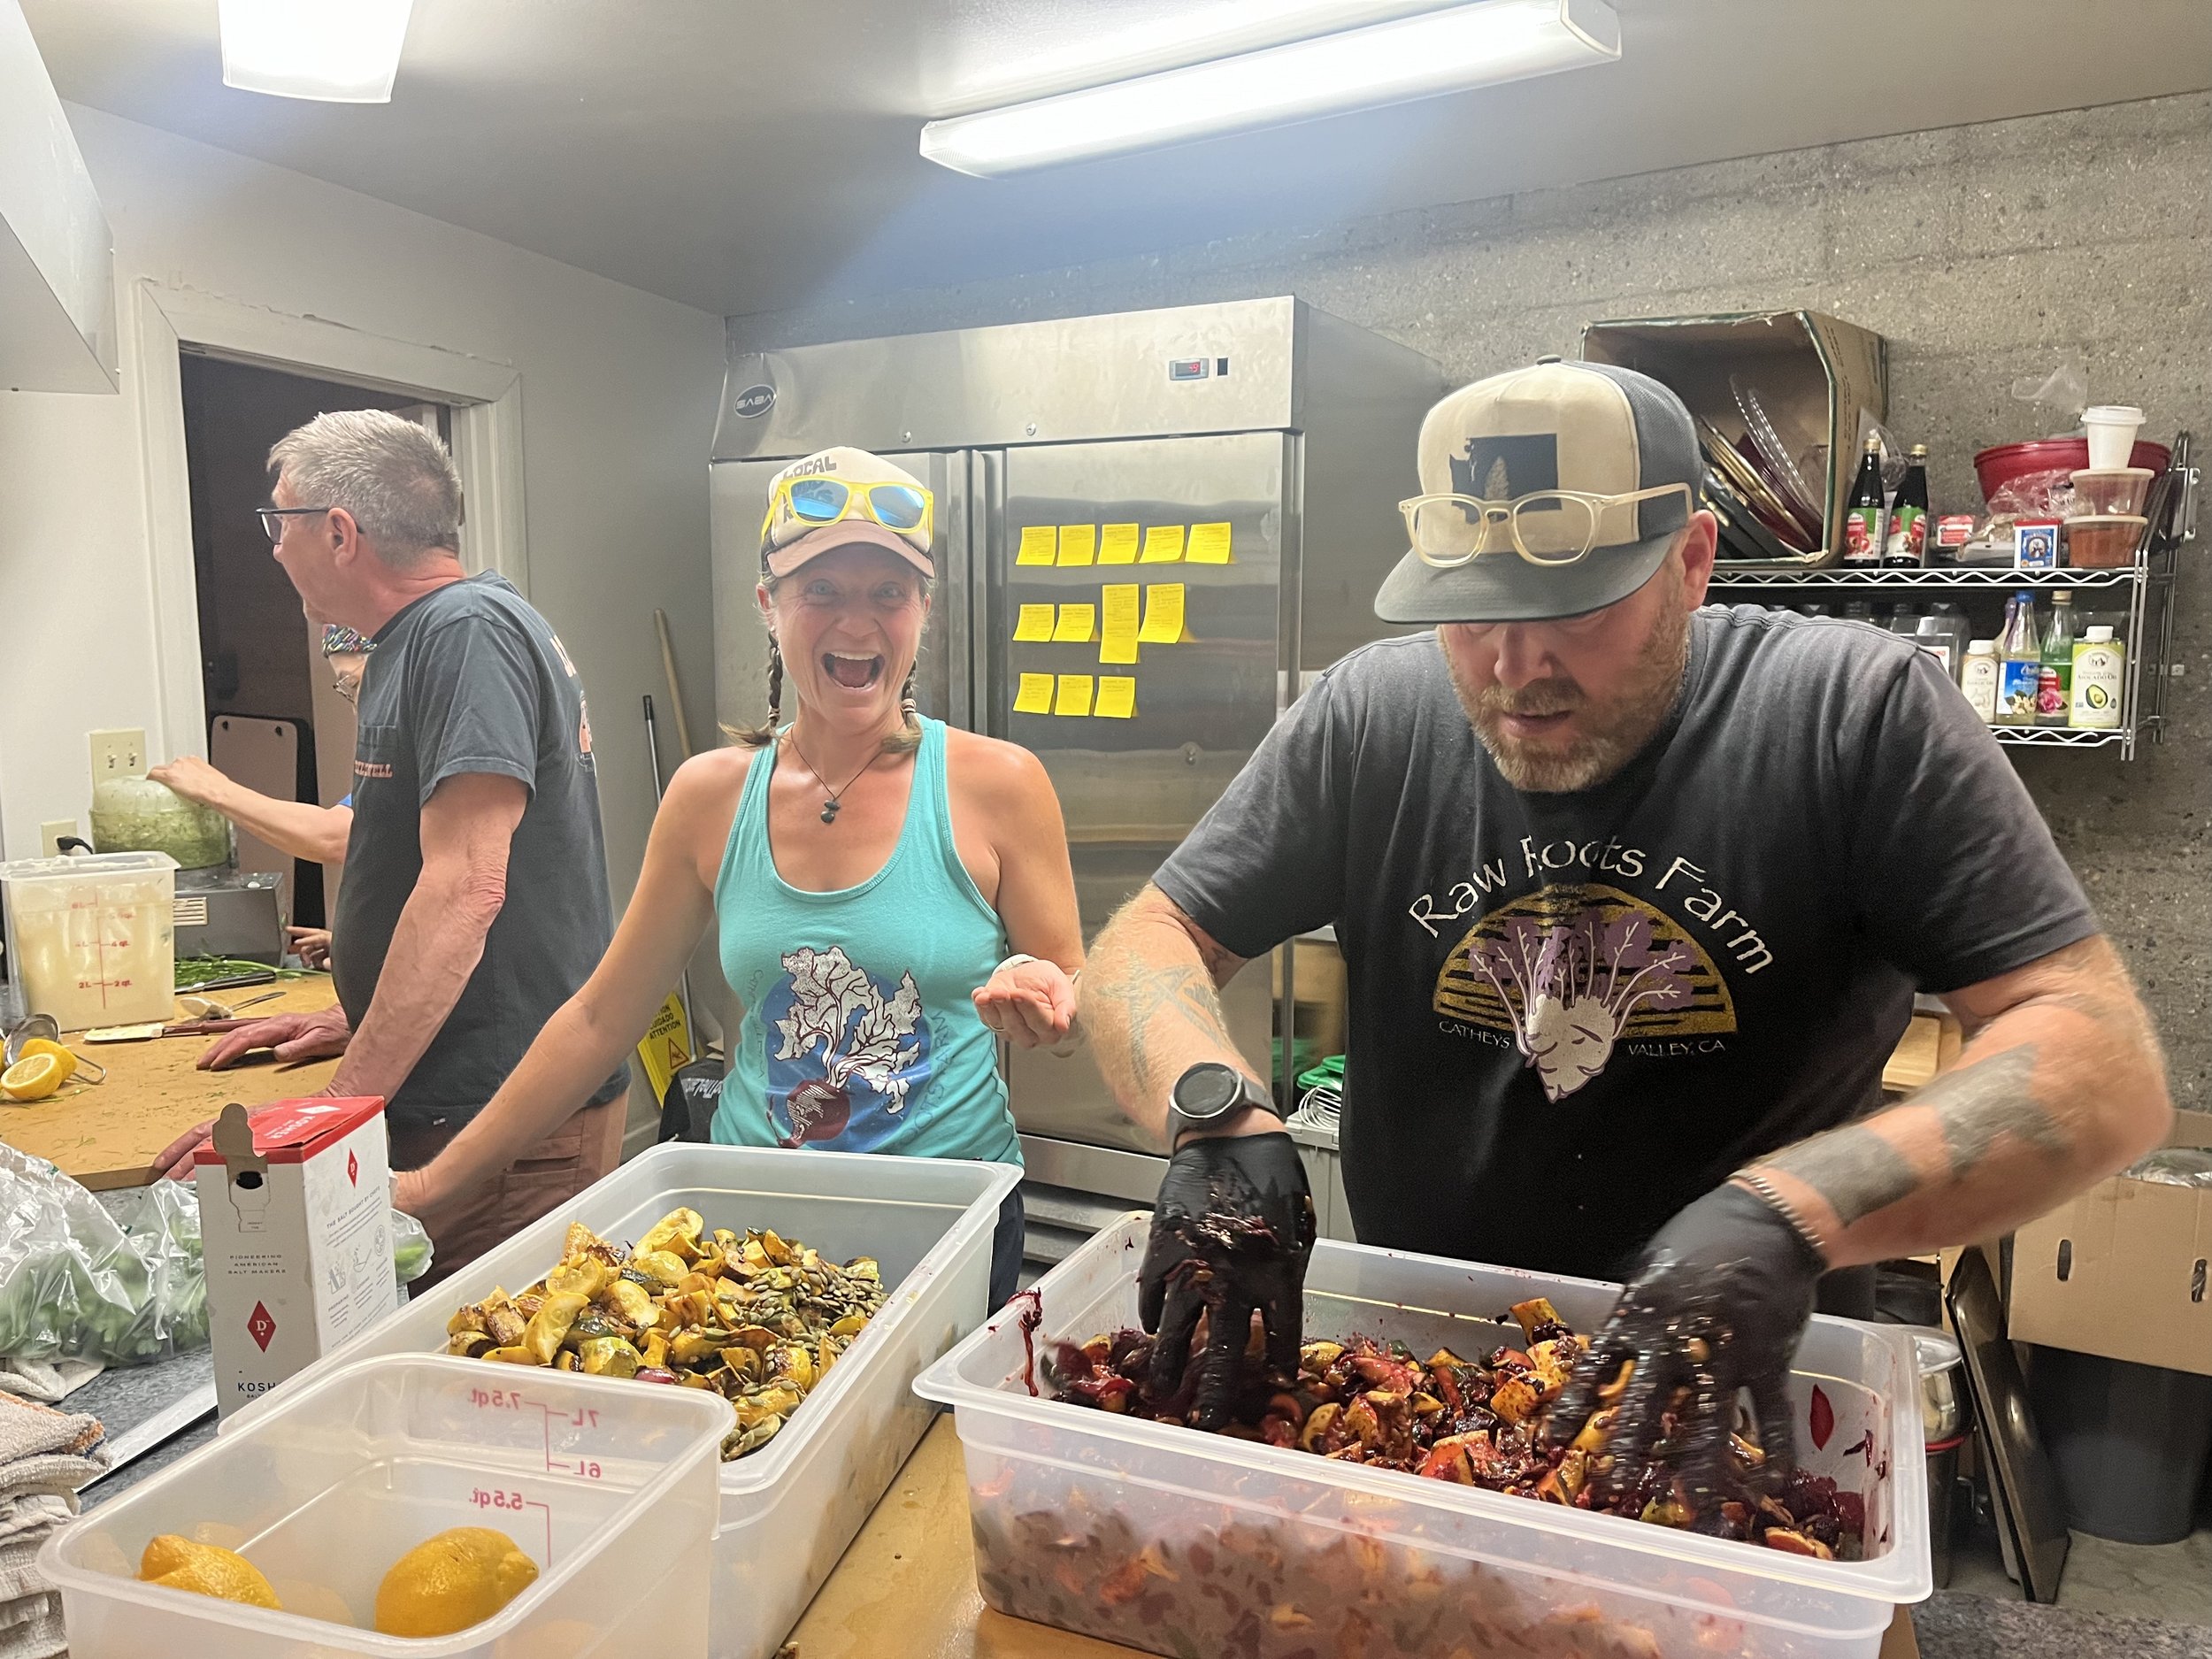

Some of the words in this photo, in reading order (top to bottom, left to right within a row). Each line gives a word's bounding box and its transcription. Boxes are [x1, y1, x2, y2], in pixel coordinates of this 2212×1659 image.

[735, 394, 772, 410] SABA
[783, 456, 837, 479] LOCAL
[1408, 858, 1507, 939] Raw
[1520, 834, 1647, 879] Roots
[1655, 856, 1774, 974] Farm
[649, 1019, 681, 1040] ATTENTION
[1439, 1019, 1511, 1049] CATHEYS
[1698, 1039, 1726, 1053] CA
[237, 1382, 276, 1392] KOSH
